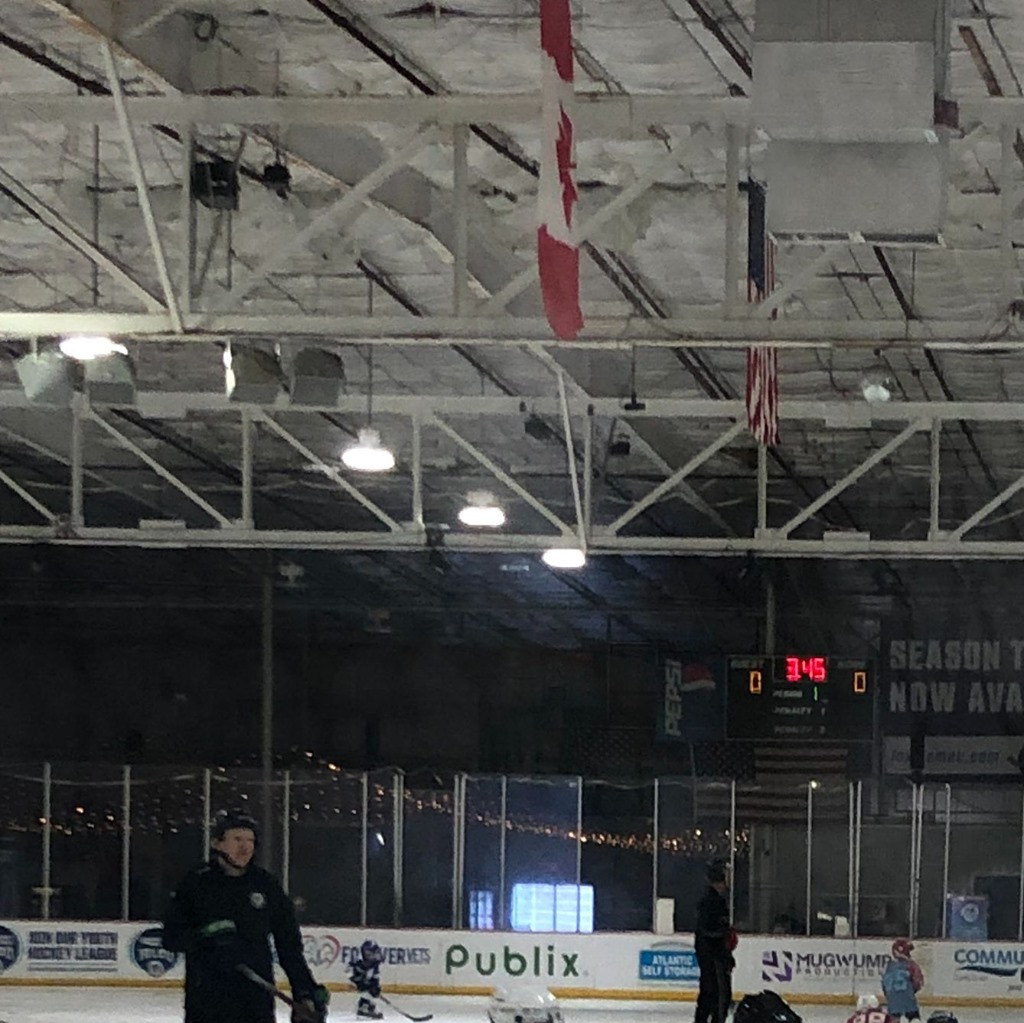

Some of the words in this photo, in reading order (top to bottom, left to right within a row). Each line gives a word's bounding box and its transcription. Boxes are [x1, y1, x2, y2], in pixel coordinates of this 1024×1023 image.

[890, 639, 1000, 671] SEASON
[665, 659, 682, 736] PEPSI
[890, 682, 956, 713] NOW
[445, 944, 580, 977] Publix
[652, 954, 694, 965] ATLANTIC
[796, 953, 892, 968] MUGWUMP
